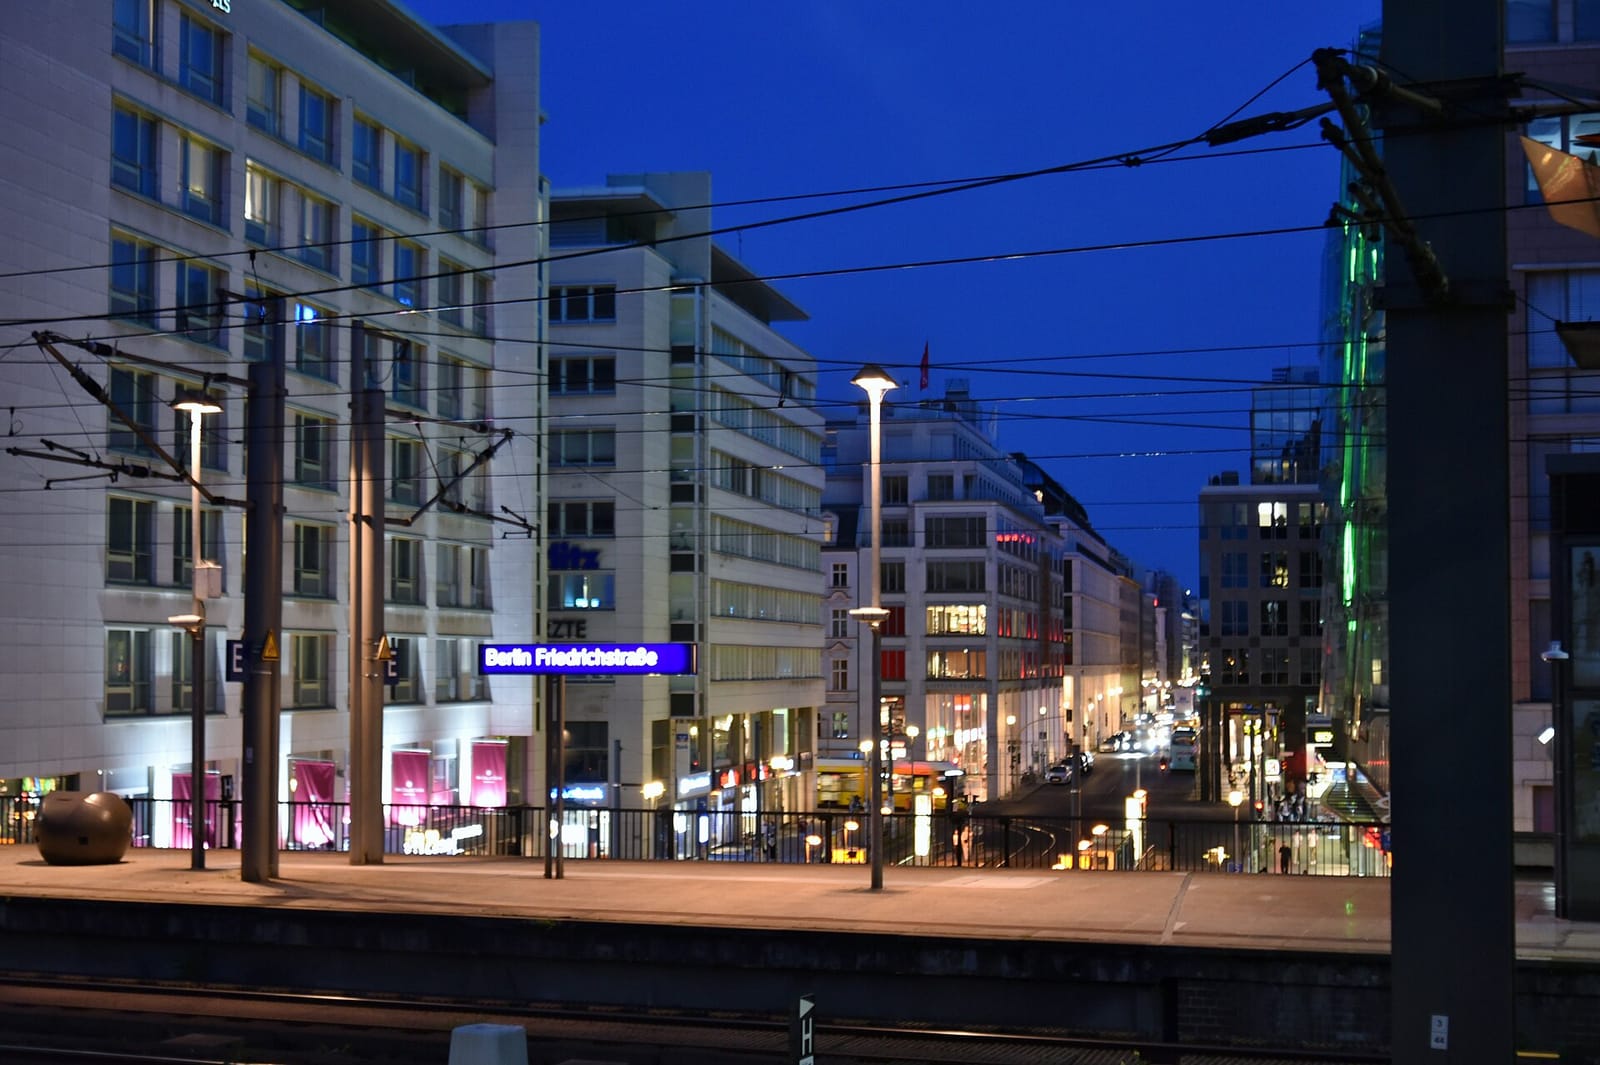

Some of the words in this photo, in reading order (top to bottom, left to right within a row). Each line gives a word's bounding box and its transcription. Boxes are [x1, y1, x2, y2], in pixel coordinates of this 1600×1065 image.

[547, 618, 587, 639] ZTE
[232, 643, 244, 673] E
[485, 647, 532, 667] Berlin
[535, 646, 659, 667] Friedrichstraße
[801, 1017, 813, 1057] H
